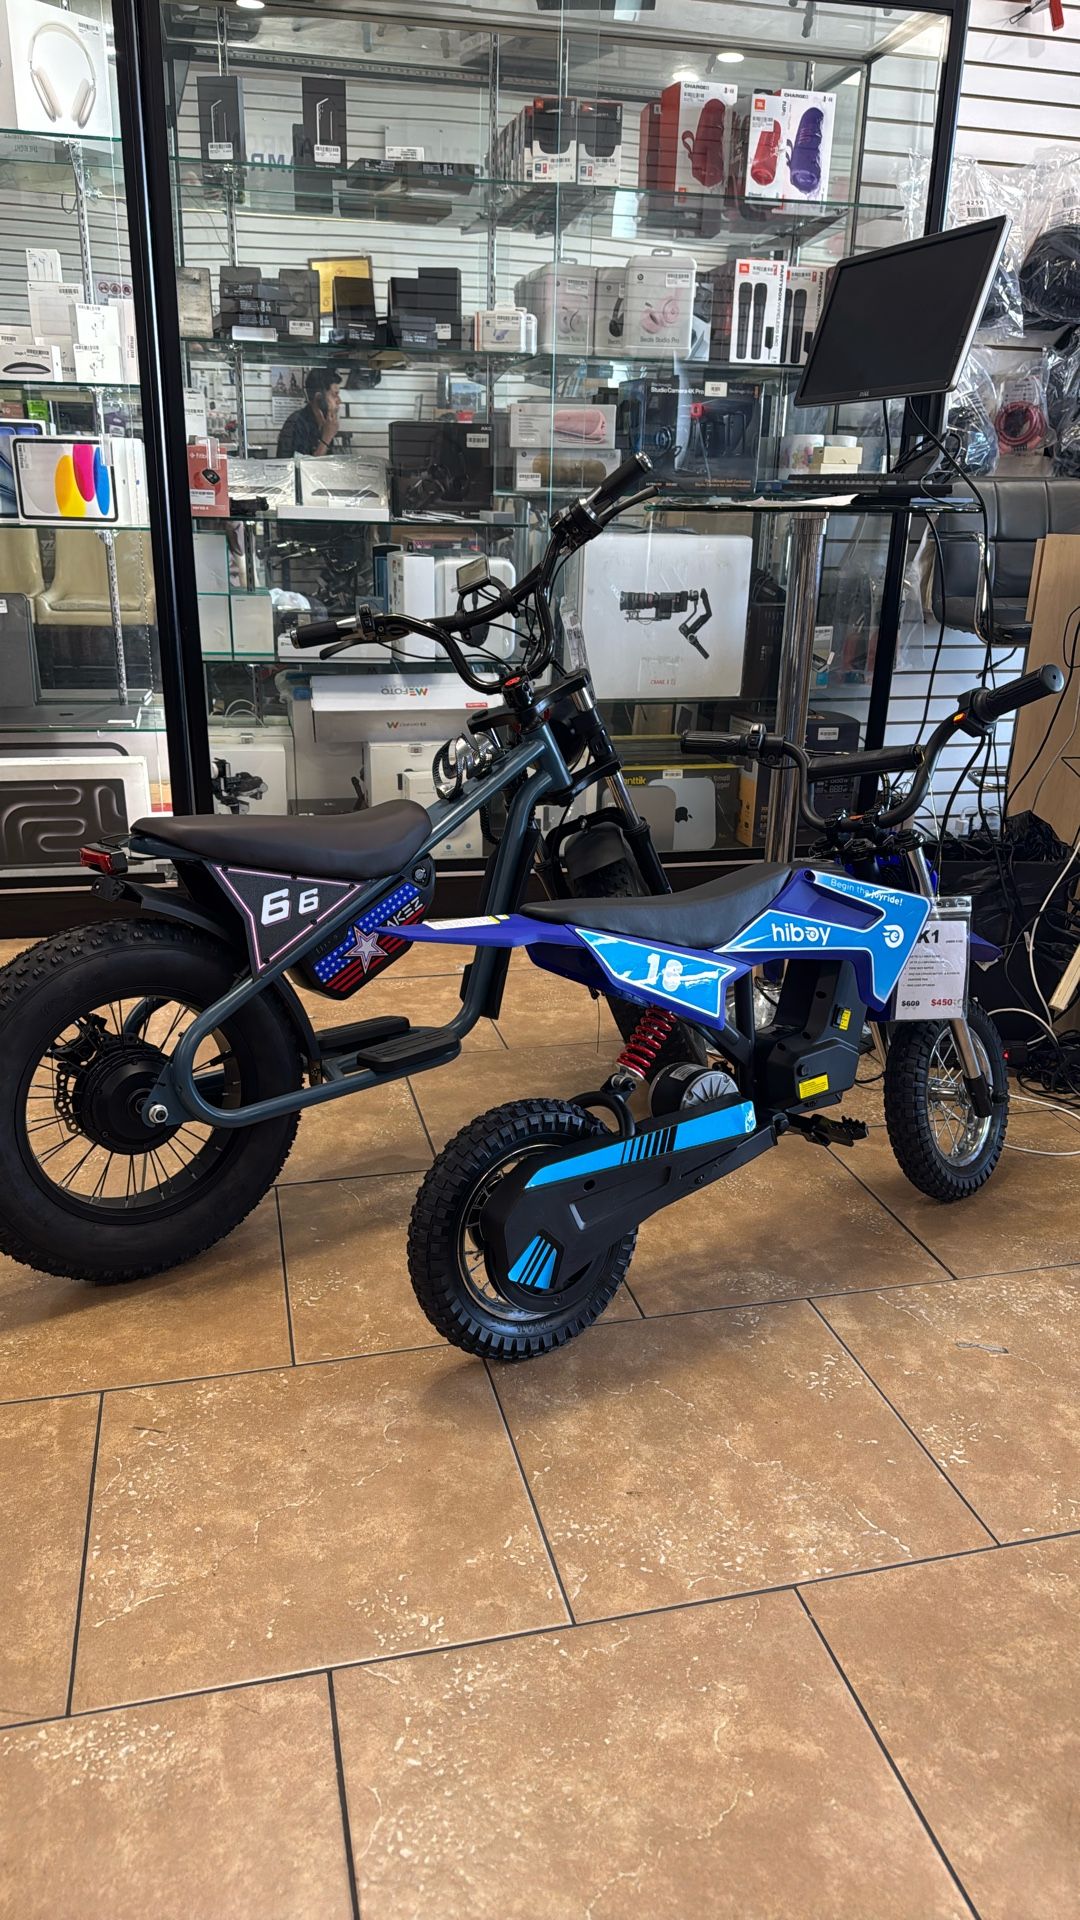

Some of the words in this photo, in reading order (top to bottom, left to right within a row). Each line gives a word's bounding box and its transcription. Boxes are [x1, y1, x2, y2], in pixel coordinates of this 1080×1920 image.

[830, 878, 855, 892] Begin
[856, 885, 870, 896] the
[870, 889, 904, 907] joyride!
[771, 922, 831, 946] hiboy
[930, 998, 953, 1007] $450
